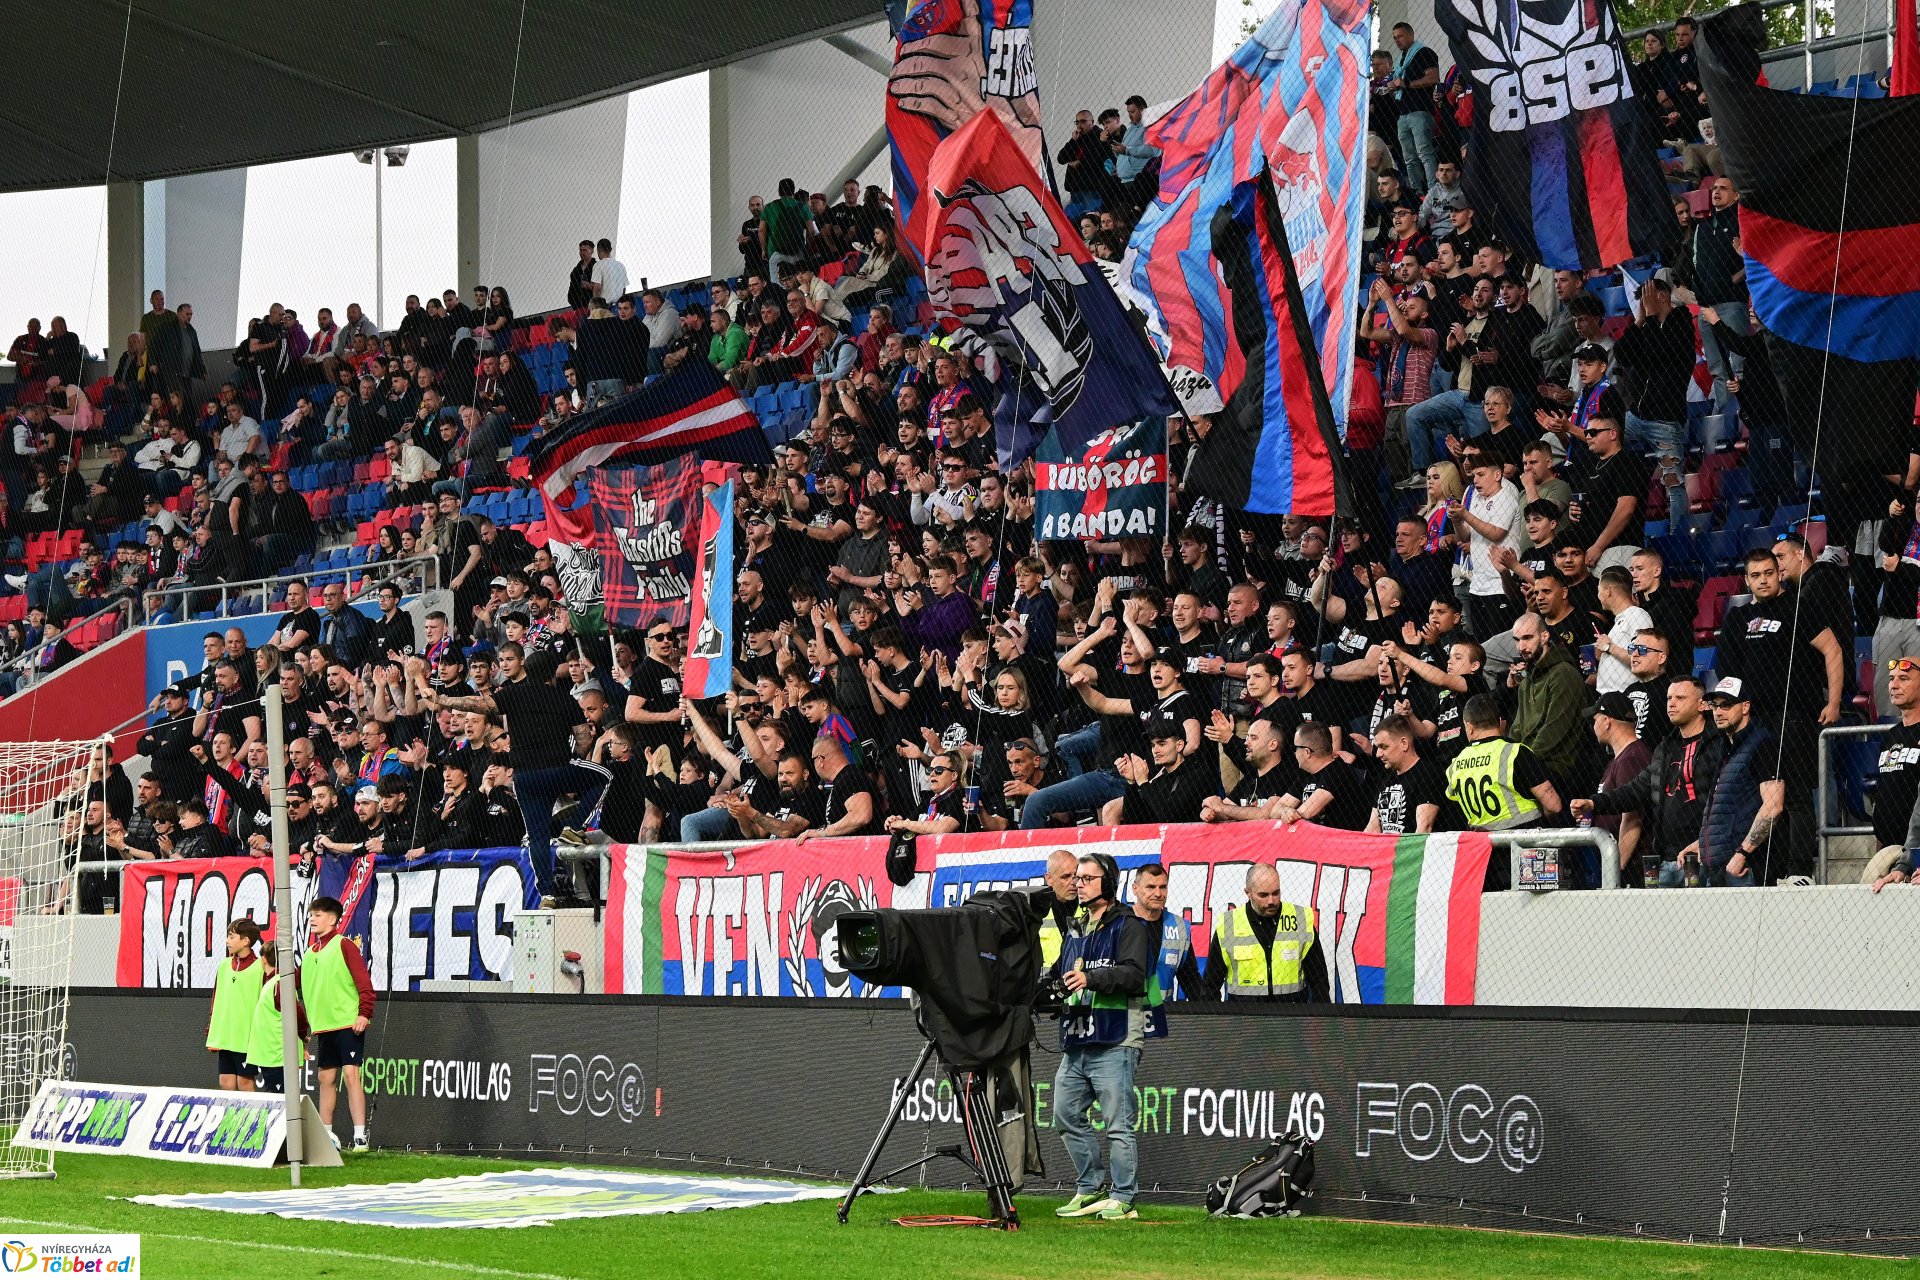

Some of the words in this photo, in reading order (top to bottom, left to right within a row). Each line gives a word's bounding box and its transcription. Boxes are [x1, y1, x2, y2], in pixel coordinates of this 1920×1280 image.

[1041, 514, 1055, 539] A
[1056, 506, 1157, 539] BANDA!
[630, 564, 691, 604] Family
[1452, 774, 1502, 820] 106
[675, 850, 784, 997] VÉN
[1164, 925, 1180, 940] 001
[1279, 913, 1298, 932] 103
[421, 1059, 512, 1101] FOCIVILÁG
[1183, 1087, 1325, 1141] FOCIVILÁG
